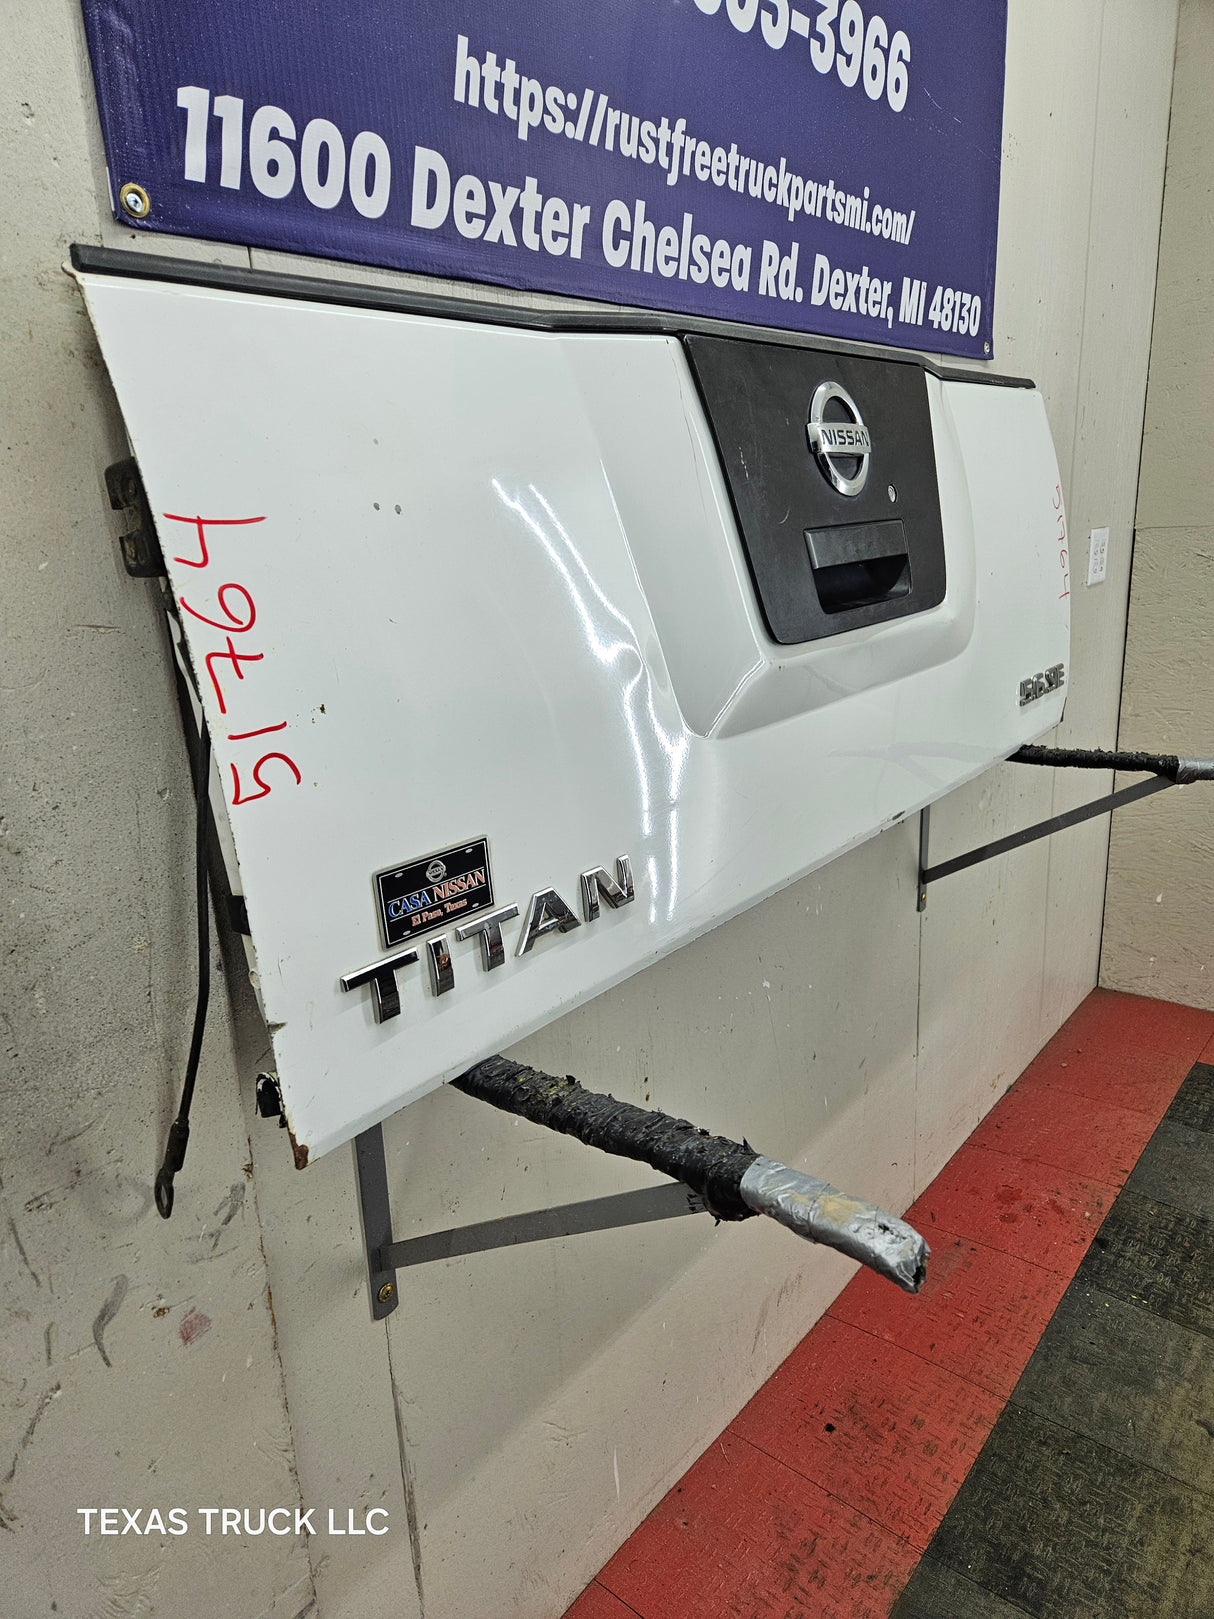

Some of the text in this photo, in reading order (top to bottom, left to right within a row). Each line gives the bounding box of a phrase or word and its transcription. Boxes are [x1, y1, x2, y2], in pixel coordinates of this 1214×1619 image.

[693, 0, 911, 112] 5-3966
[454, 34, 915, 245] https://rustfreetruckpartsmi.com/
[177, 85, 981, 337] 11600 Dexter Chelsea Rd. Dexter, MI 48130
[821, 429, 870, 447] NISSAN
[163, 513, 301, 805] 51764
[340, 854, 635, 1024] TITAN
[388, 868, 486, 918] CASA NISSAN
[411, 914, 421, 927] El
[444, 899, 467, 913] Texas
